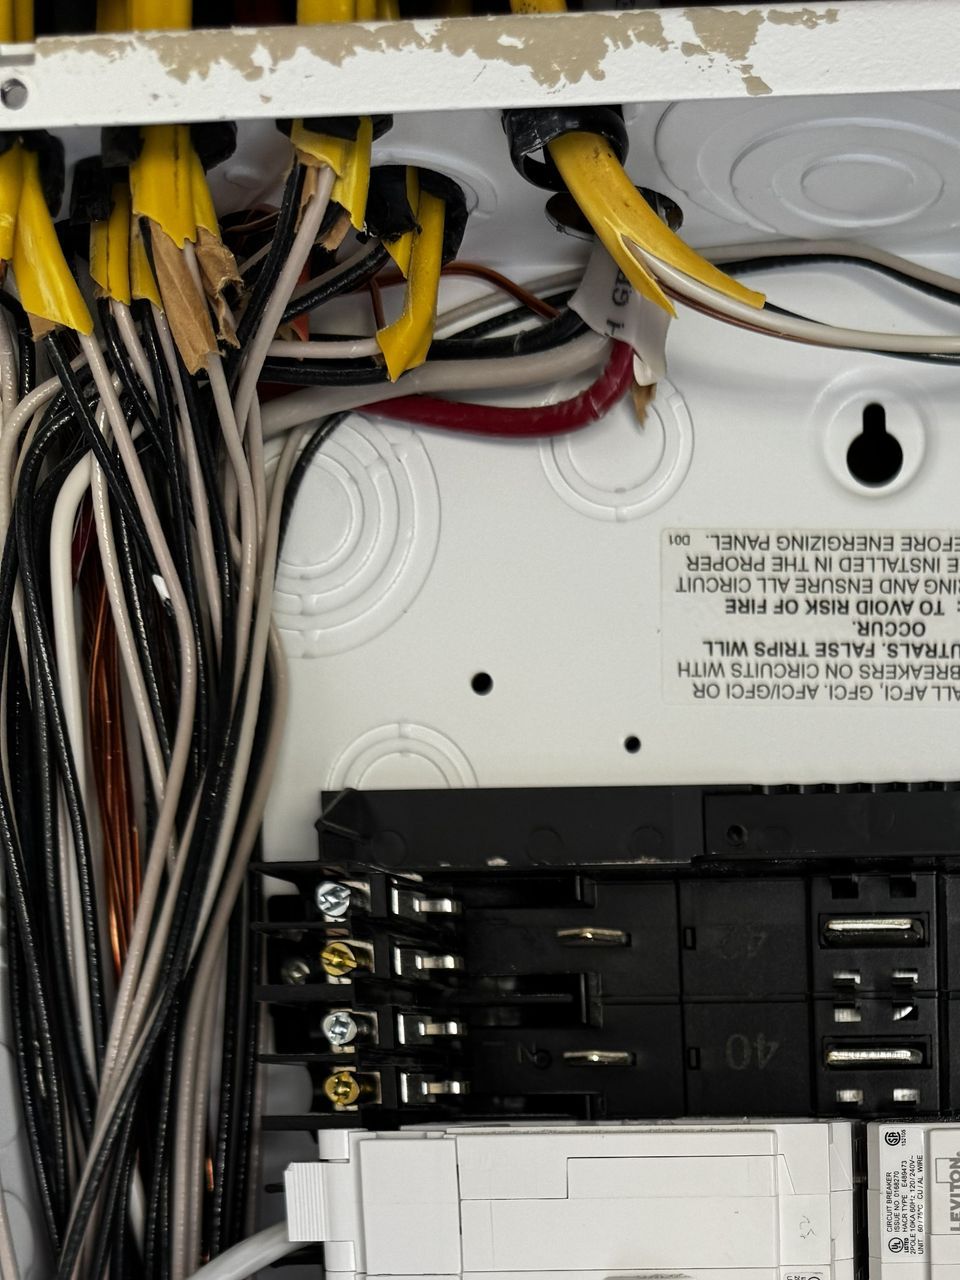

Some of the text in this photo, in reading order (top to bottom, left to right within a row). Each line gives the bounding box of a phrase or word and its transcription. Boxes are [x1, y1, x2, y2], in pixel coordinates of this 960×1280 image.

[669, 534, 690, 545] D01
[706, 535, 769, 550] PANEL.
[777, 536, 894, 551] ENERGIZING
[687, 556, 765, 571] PROPER
[772, 556, 809, 572] THE
[815, 557, 832, 572] IN
[839, 557, 940, 573] INSTALLED
[676, 577, 751, 593] CIRCUIT
[757, 577, 790, 593] ALL
[795, 578, 873, 594] ENSURE
[880, 579, 919, 594] AND
[726, 599, 766, 614] FIRE
[774, 599, 798, 614] OF
[805, 599, 849, 615] RISK
[856, 600, 914, 615] AVOID
[920, 600, 944, 615] TO
[853, 621, 925, 637] OCCUR.
[703, 641, 748, 656] WILL
[755, 641, 808, 657] TRIPS
[816, 642, 875, 658] FALSE
[678, 662, 725, 677] WITH
[731, 662, 819, 679] CIRCUITS
[826, 663, 853, 679] ON
[859, 664, 960, 680] BREAKERS
[693, 683, 720, 699] OR
[727, 684, 819, 699] AFCI/GFCI
[825, 685, 873, 700] GFCI.
[880, 683, 927, 701] AFCI,
